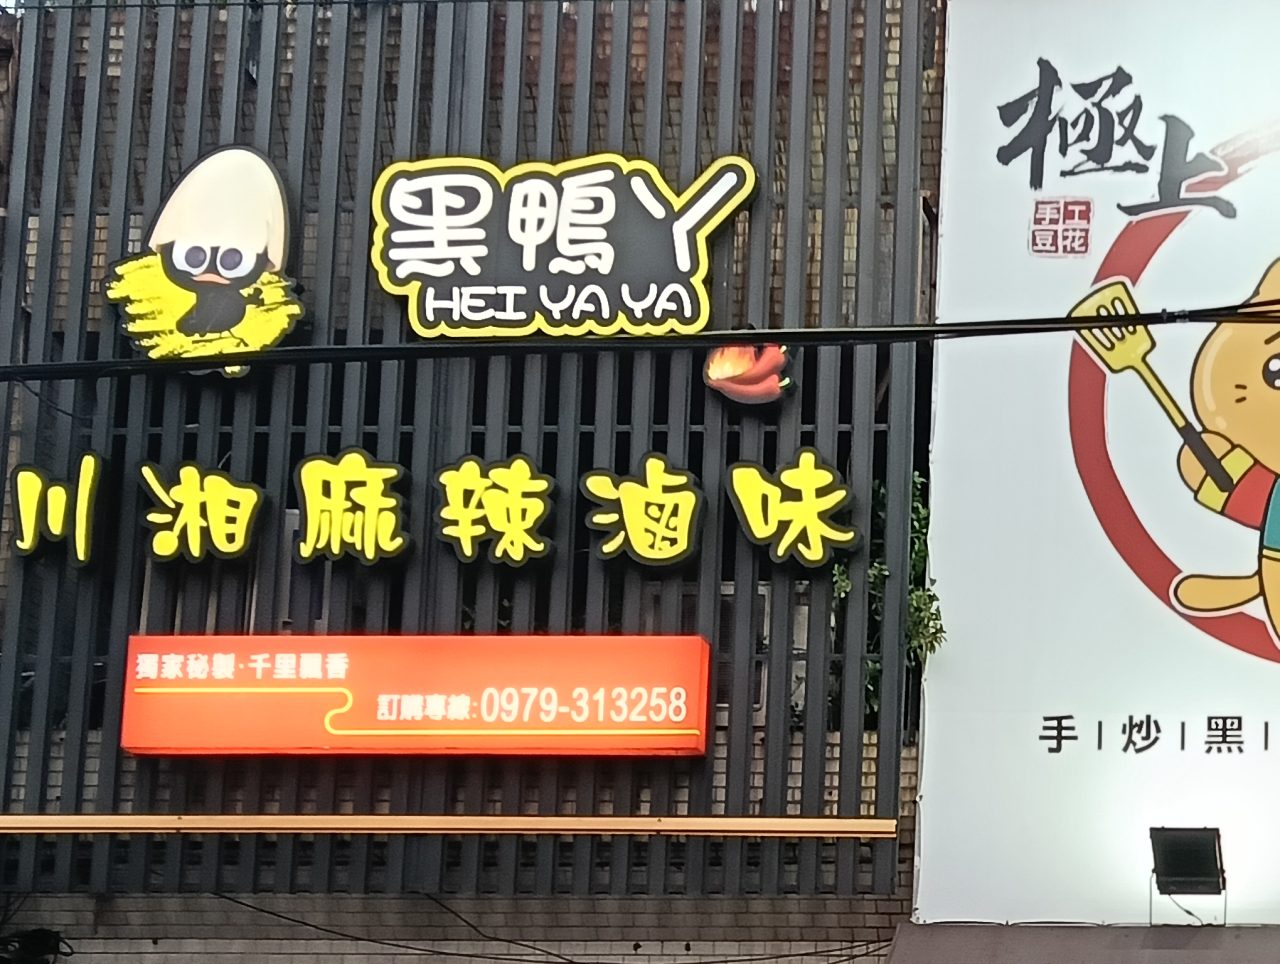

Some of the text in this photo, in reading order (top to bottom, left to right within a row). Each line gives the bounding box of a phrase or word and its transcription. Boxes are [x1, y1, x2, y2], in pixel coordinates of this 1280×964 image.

[998, 57, 1236, 219] 極上
[426, 290, 525, 322] HEI
[15, 452, 856, 565] 川湘麻辣滷味
